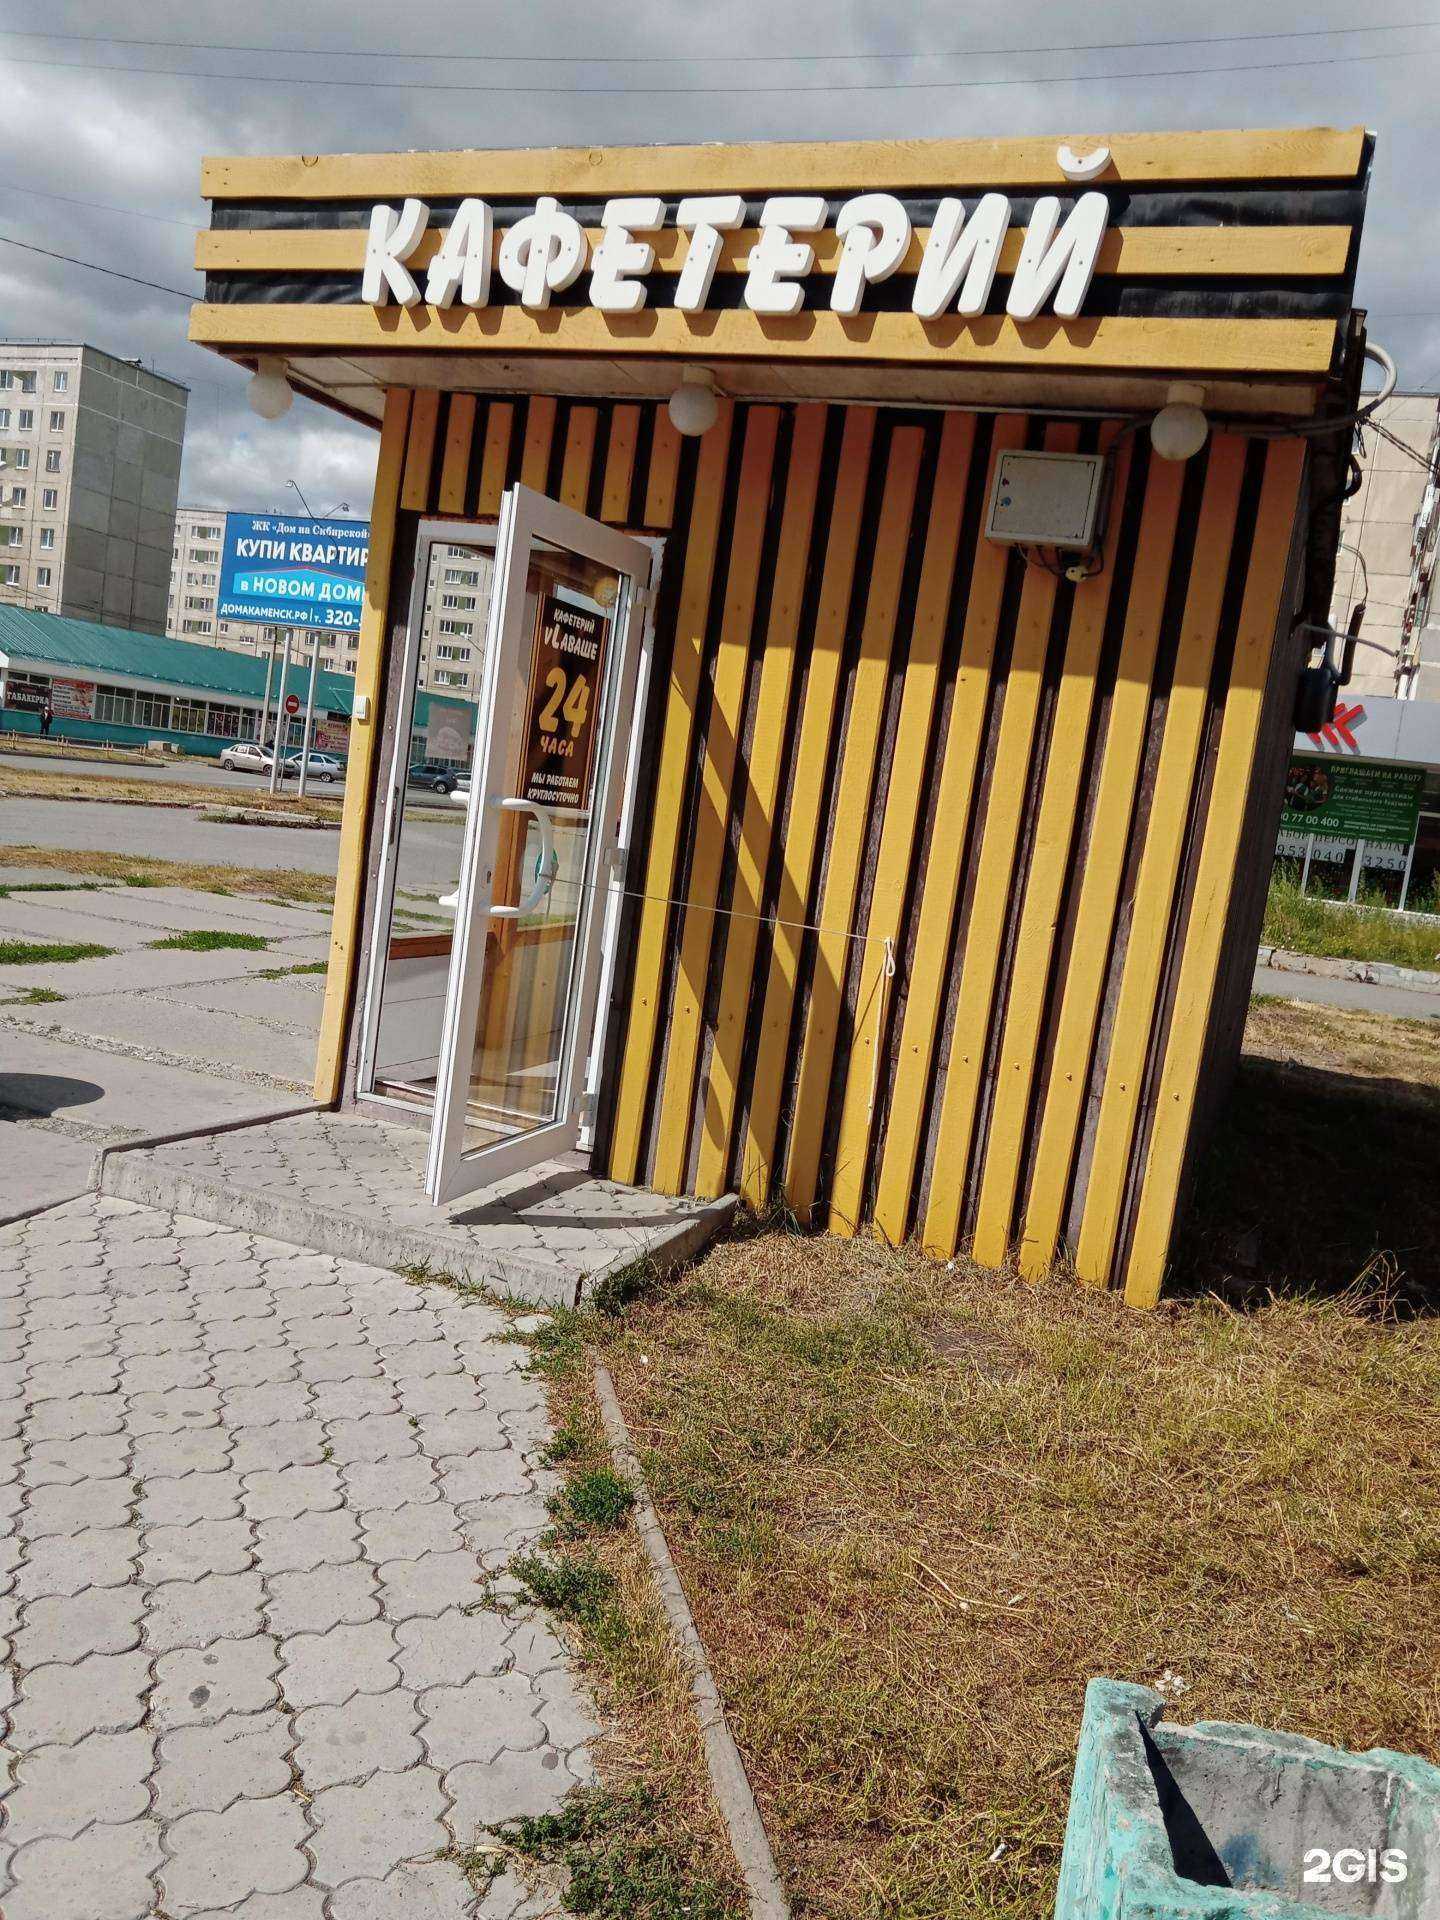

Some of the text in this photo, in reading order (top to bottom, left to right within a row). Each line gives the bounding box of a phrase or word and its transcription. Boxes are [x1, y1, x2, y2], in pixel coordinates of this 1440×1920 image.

[362, 145, 1112, 322] КАФЕТЕРИЙ
[251, 520, 270, 533] ЖК
[297, 527, 310, 535] на
[236, 538, 286, 561] КУПИ
[240, 579, 249, 591] в
[253, 577, 315, 598] НОВОМ
[220, 603, 308, 621] ДОМАКАМЕНСК.РФ
[553, 608, 596, 634] КАФЕТЕРИЙ
[538, 667, 590, 738] 24
[540, 735, 575, 758] ЧАСА
[531, 772, 580, 789] МЫ РАБОТАЕМ
[527, 787, 580, 804] КРУГЛОСУТОЧНО
[1291, 813, 1304, 823] 77
[1306, 815, 1319, 825] 00
[1320, 816, 1340, 828] 400
